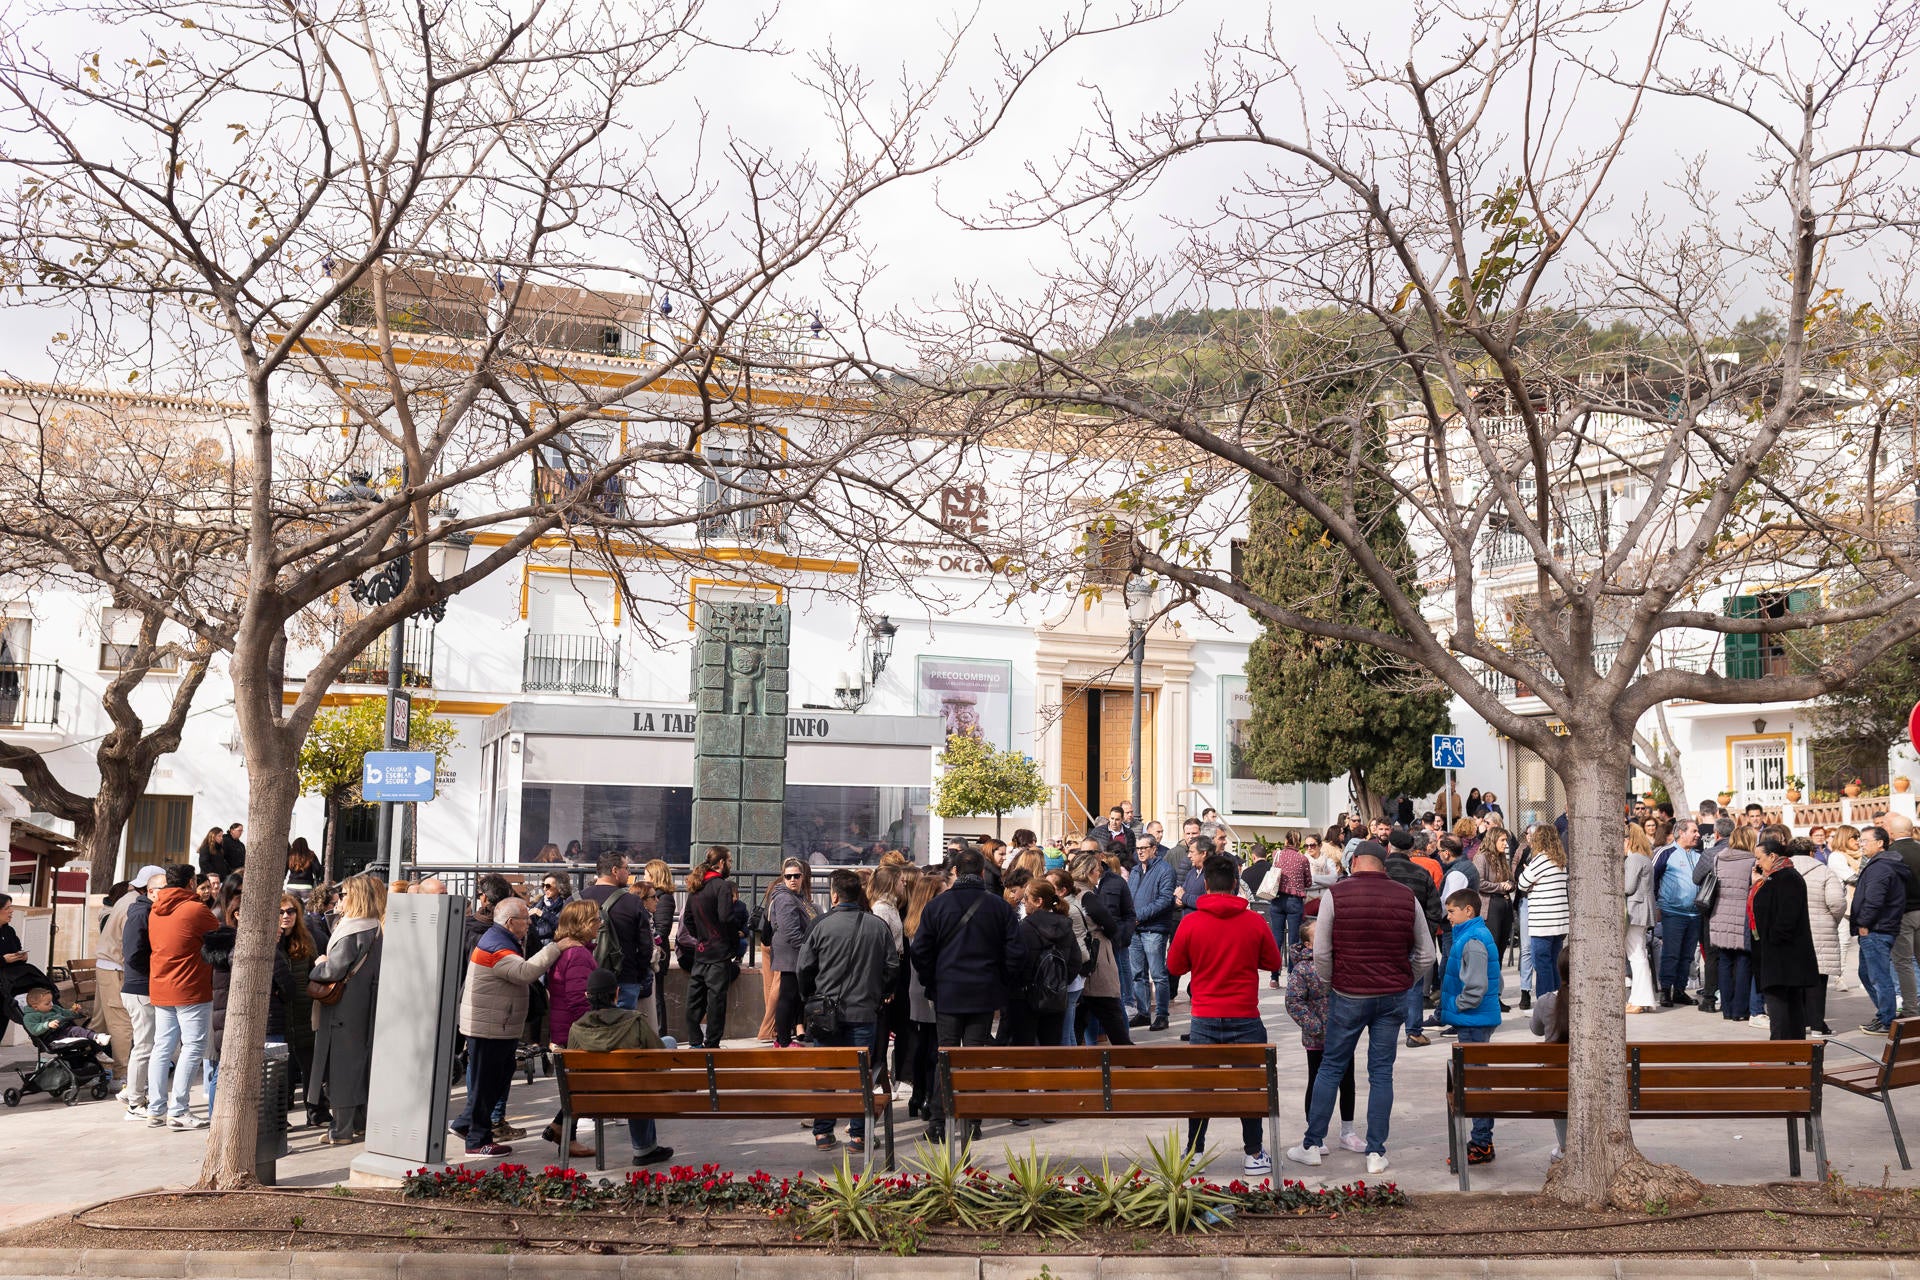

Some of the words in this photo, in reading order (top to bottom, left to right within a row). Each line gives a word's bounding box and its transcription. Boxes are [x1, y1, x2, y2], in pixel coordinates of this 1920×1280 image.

[931, 671, 1000, 681] PRECOLOMBINO
[633, 712, 655, 731] LA
[788, 717, 829, 737] INFO
